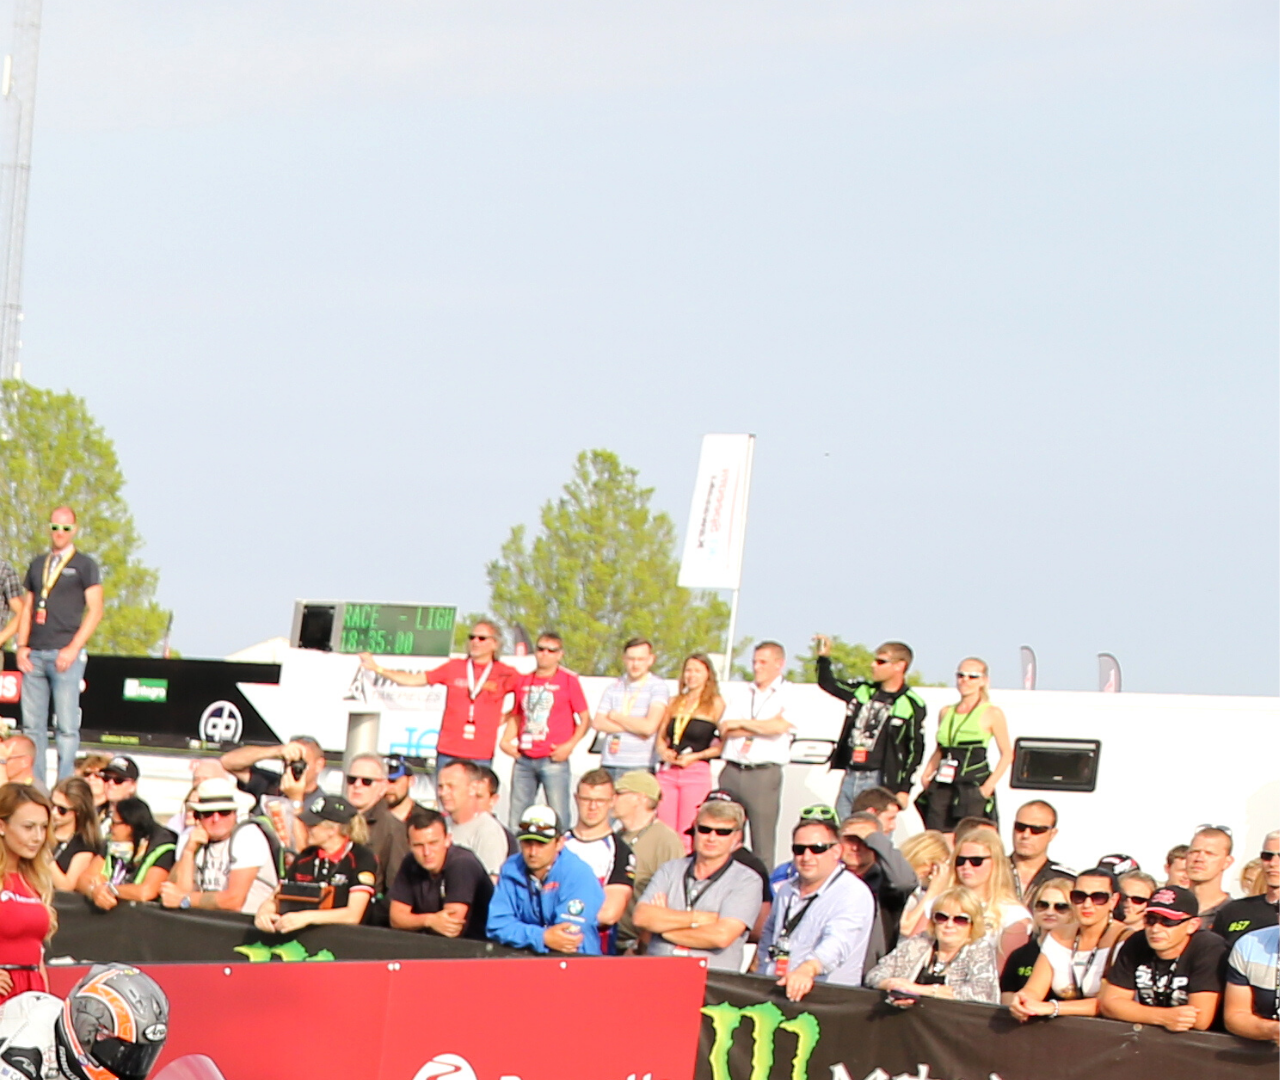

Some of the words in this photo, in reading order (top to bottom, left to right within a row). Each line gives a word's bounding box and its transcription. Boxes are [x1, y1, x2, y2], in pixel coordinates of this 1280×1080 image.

[343, 603, 381, 629] RACE
[415, 606, 456, 632] LIGH
[341, 630, 414, 655] 18:35:00
